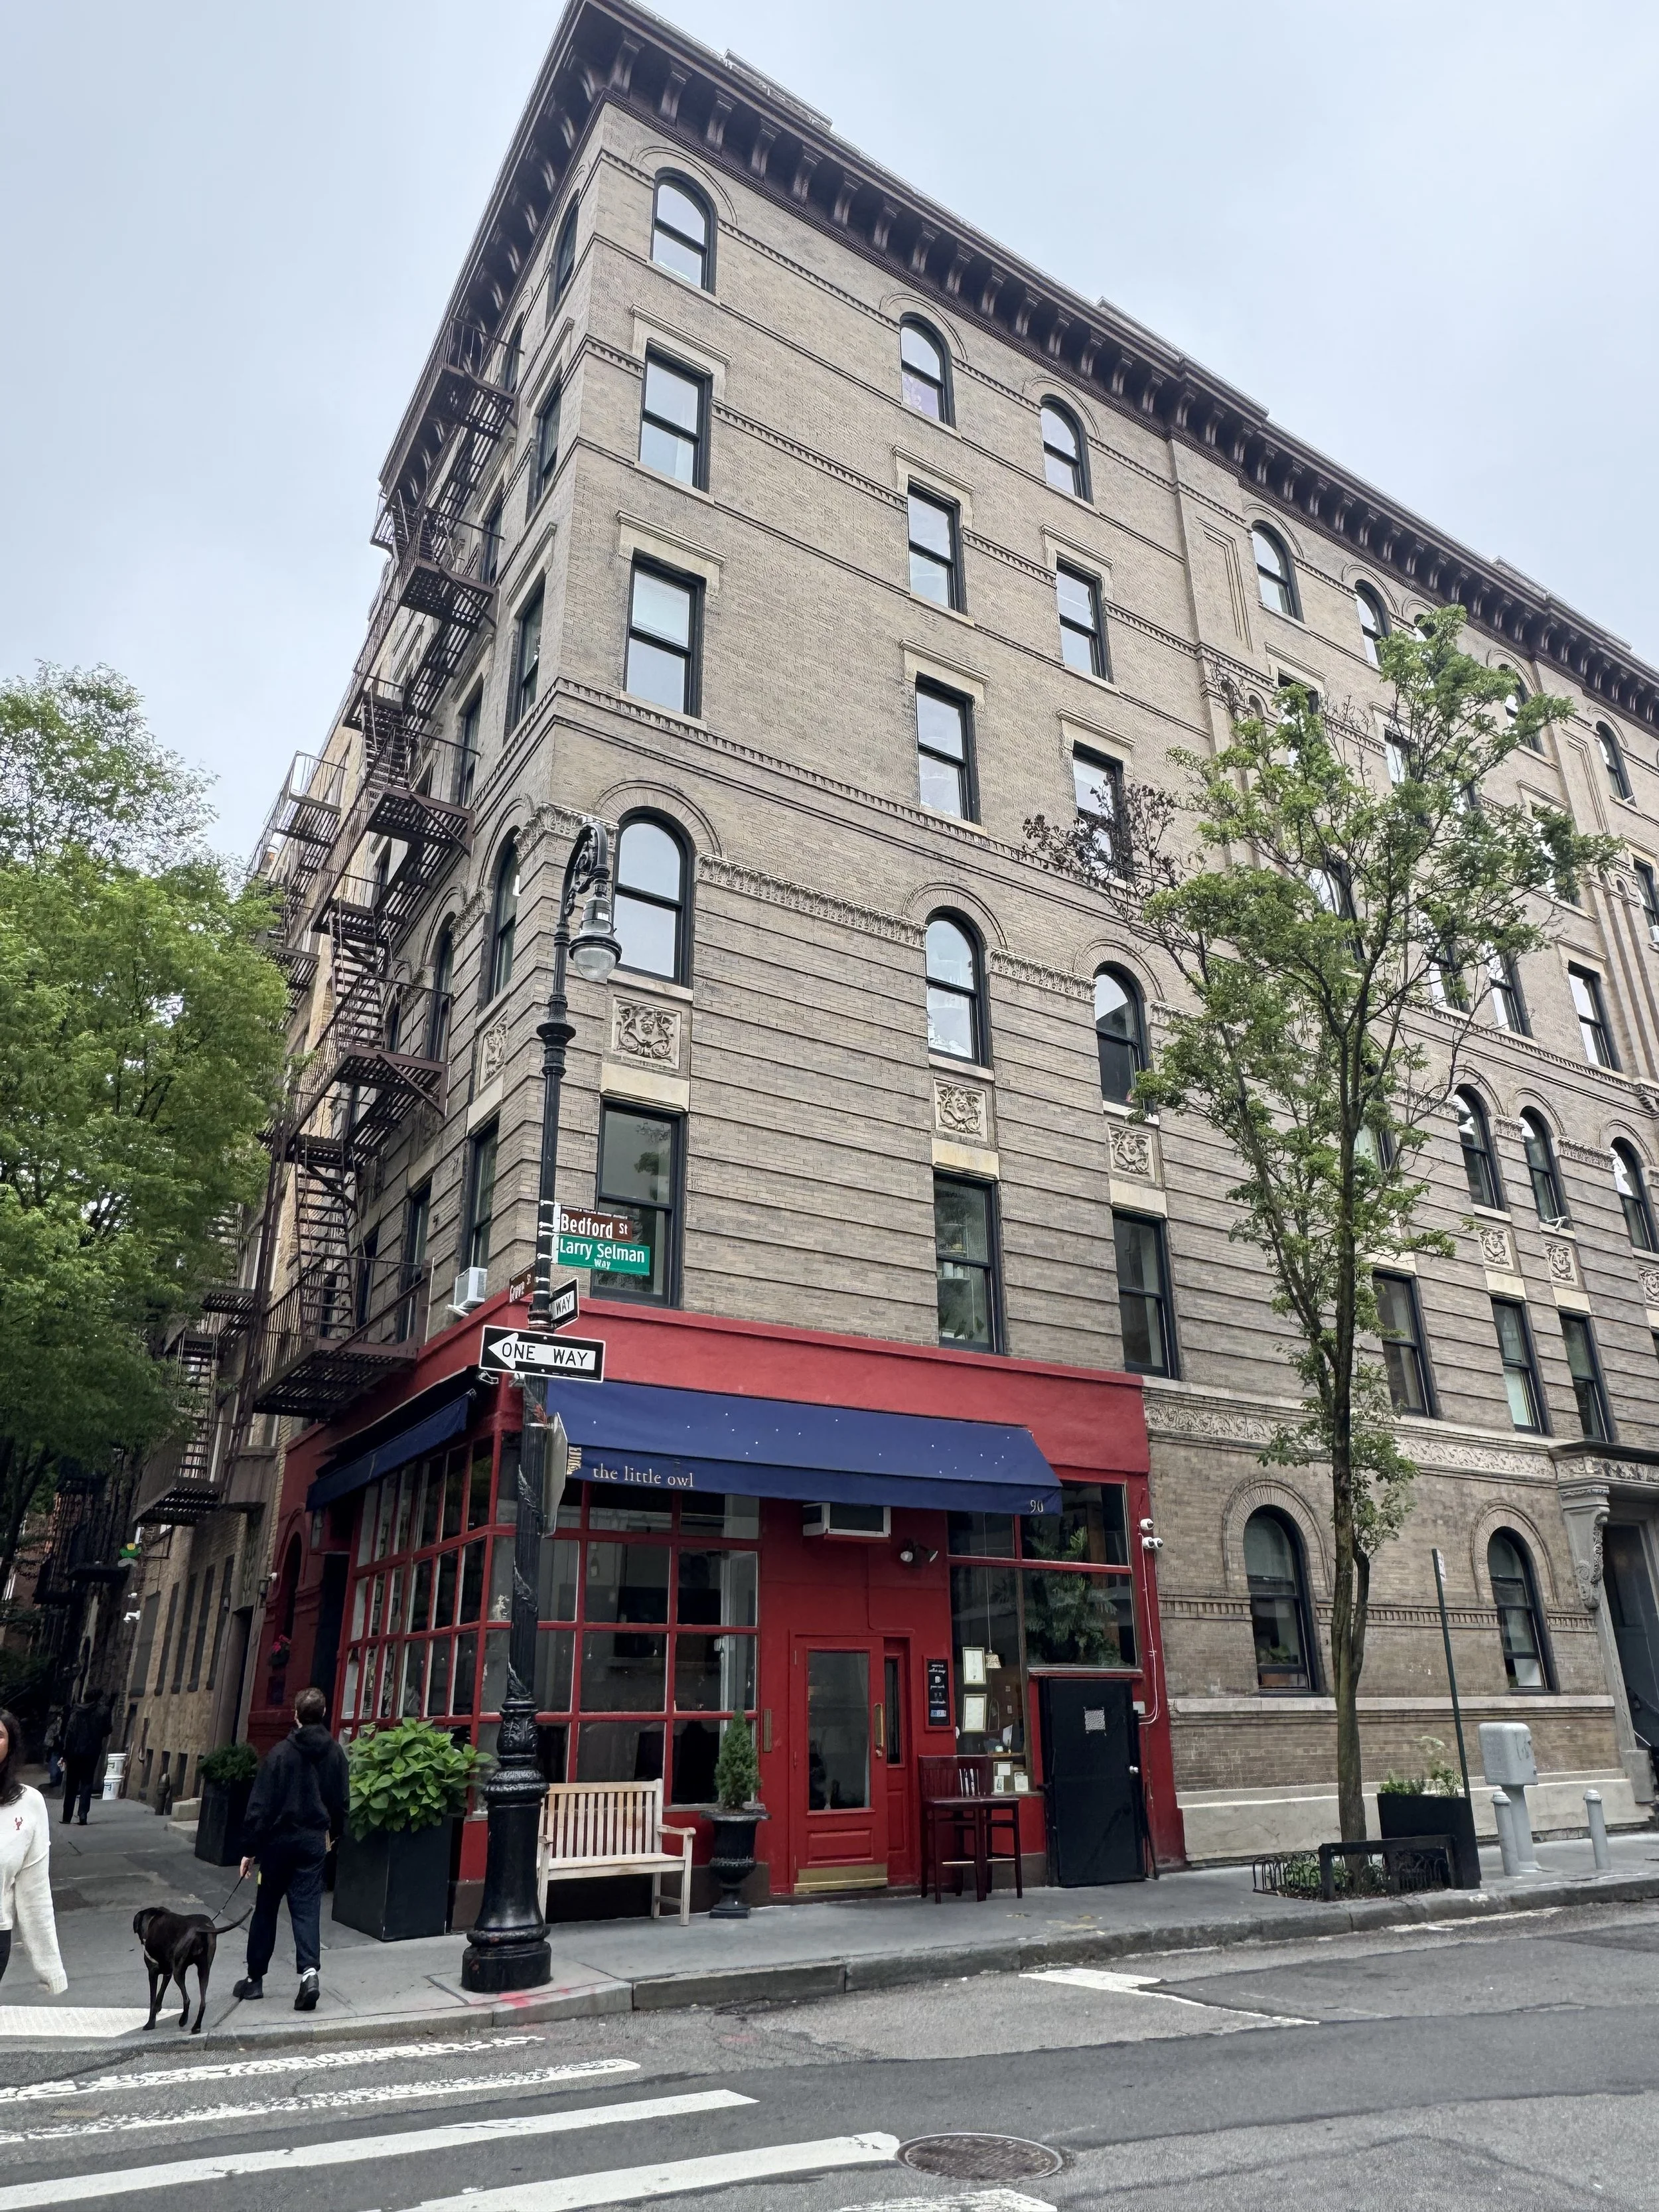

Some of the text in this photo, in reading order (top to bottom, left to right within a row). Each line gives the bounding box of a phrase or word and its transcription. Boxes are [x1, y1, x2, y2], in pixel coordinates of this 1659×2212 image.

[561, 1213, 628, 1239] Bedford St
[559, 1238, 645, 1263] Larry Selman
[594, 1258, 611, 1270] Way
[555, 1294, 571, 1316] WAY
[502, 1342, 588, 1367] ONE WAY
[593, 1463, 694, 1488] the little owl
[1030, 1499, 1044, 1513] 90
